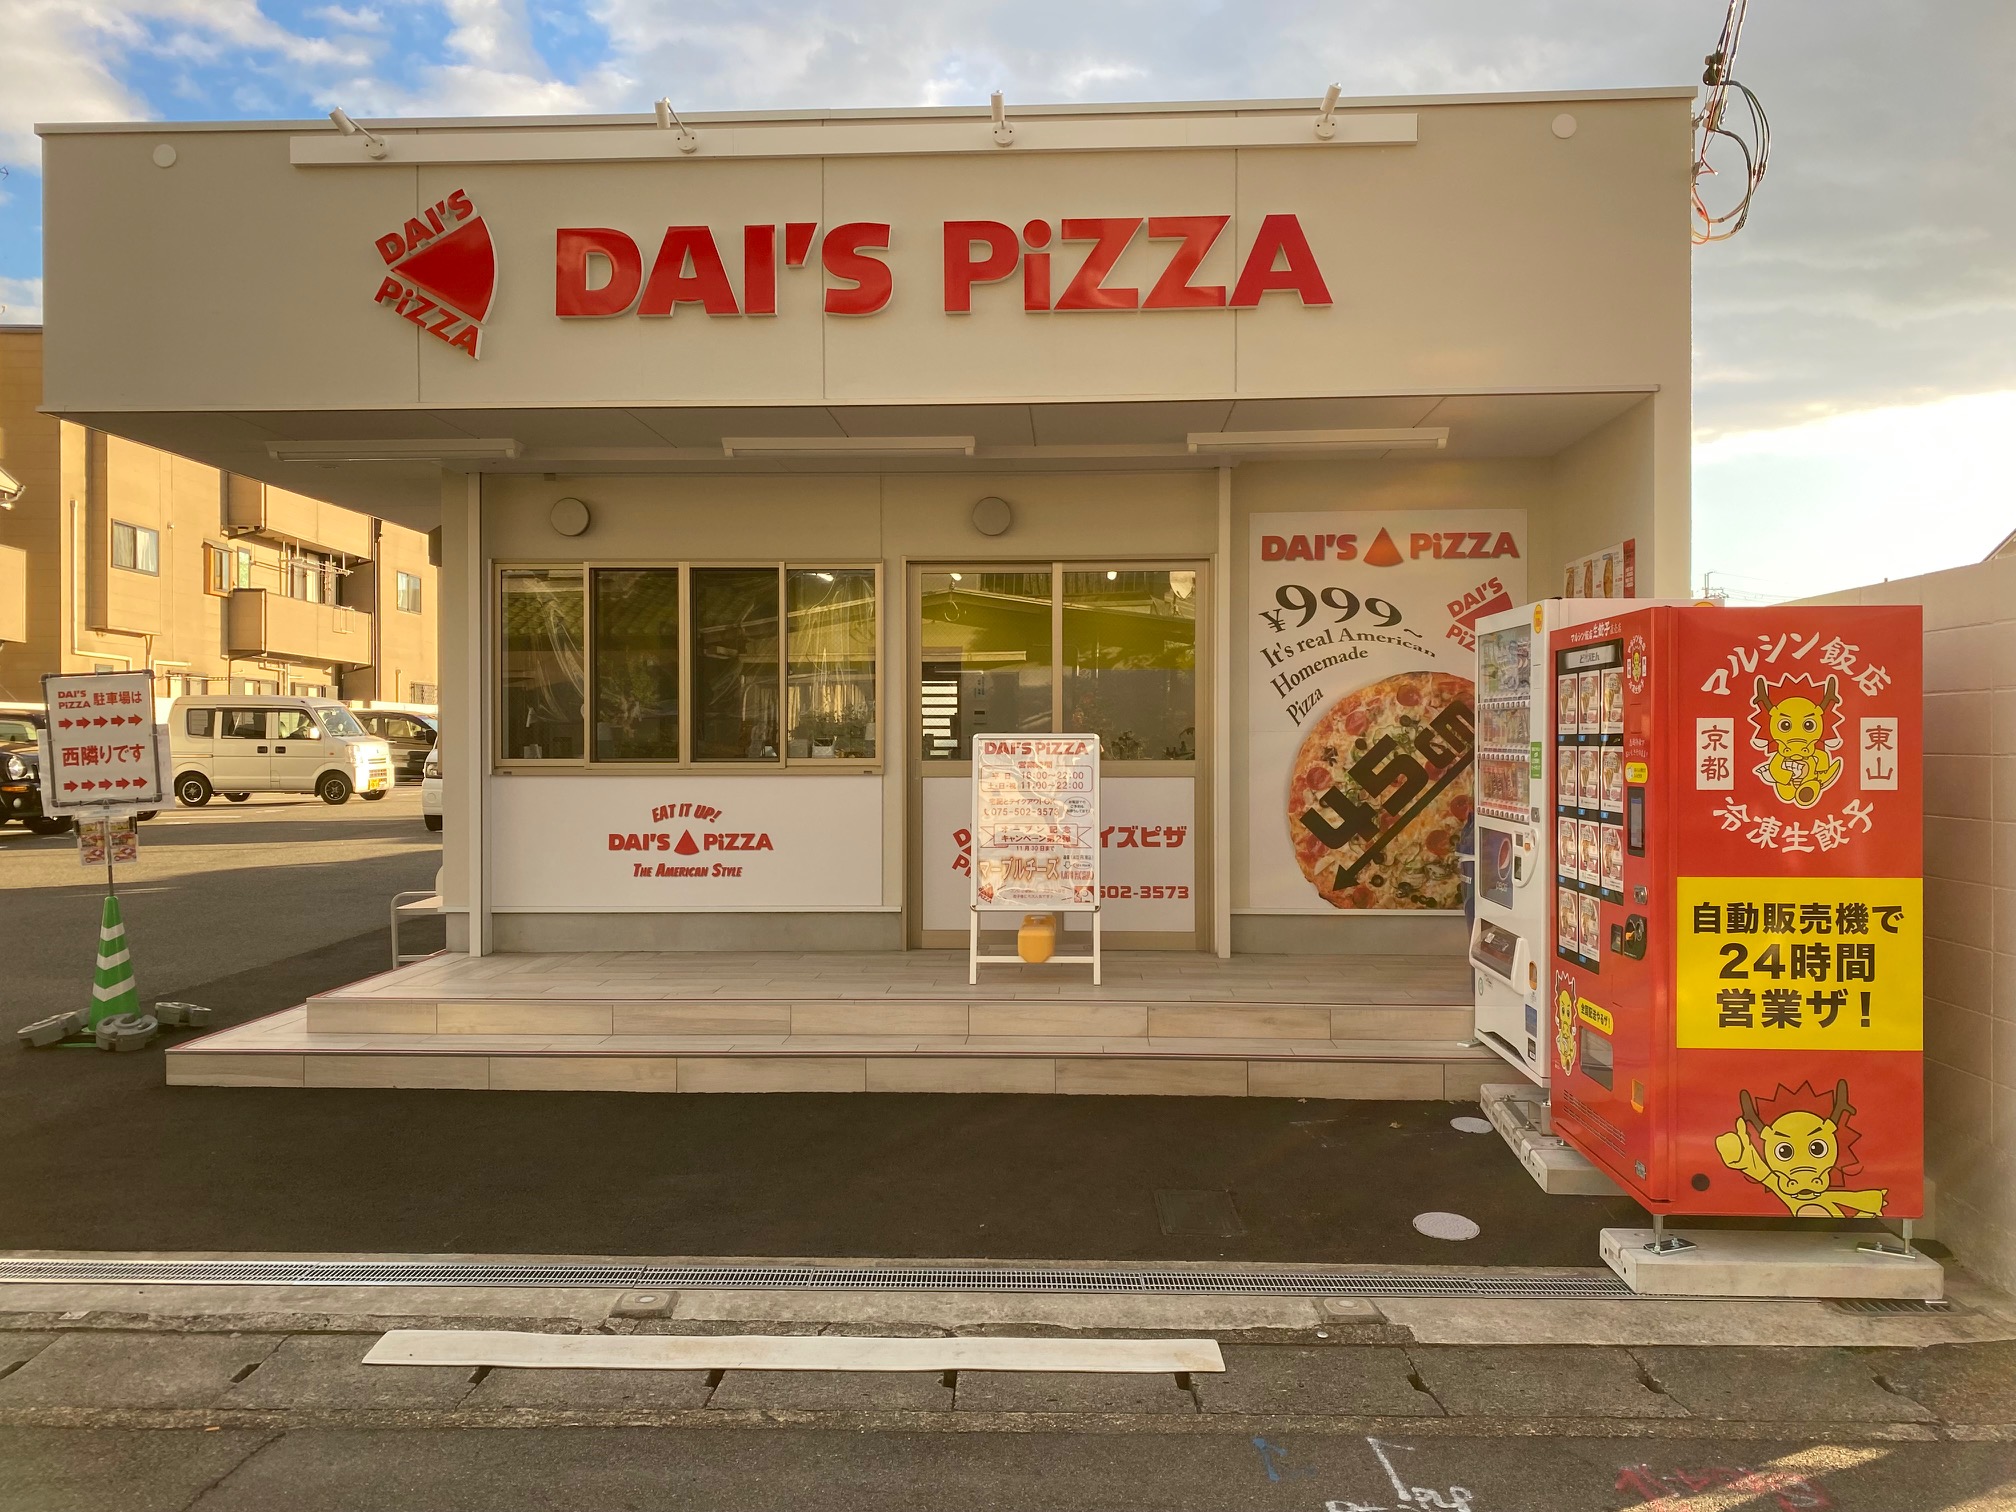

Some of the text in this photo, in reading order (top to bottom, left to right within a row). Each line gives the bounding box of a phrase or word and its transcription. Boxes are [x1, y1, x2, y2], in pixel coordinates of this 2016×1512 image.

[375, 188, 477, 266] DAI'S
[556, 222, 893, 318] DAI'S
[1261, 534, 1358, 561] DAI'S
[1446, 576, 1504, 618] DAI'S
[1260, 627, 1436, 669] It's real American
[1445, 624, 1475, 653] PiZ
[1269, 646, 1369, 700] Homemade
[1701, 631, 1892, 697] マルシン飯店
[58, 690, 87, 699] DAI'S
[93, 691, 142, 706] 駐車場は
[1285, 688, 1324, 727] Pizza
[62, 744, 145, 767] 西隣りです
[984, 742, 1032, 755] DAI'S
[1700, 725, 1730, 781] 京都
[1865, 725, 1893, 781] 東山
[652, 803, 722, 823] EAT IT UP!
[991, 808, 1060, 816] 075-502-3573
[1713, 796, 1874, 853] 冷凍生餃子
[608, 833, 671, 851] DAI'S
[1693, 901, 1904, 935] 自動販売機で
[1719, 942, 1876, 983] 24時間
